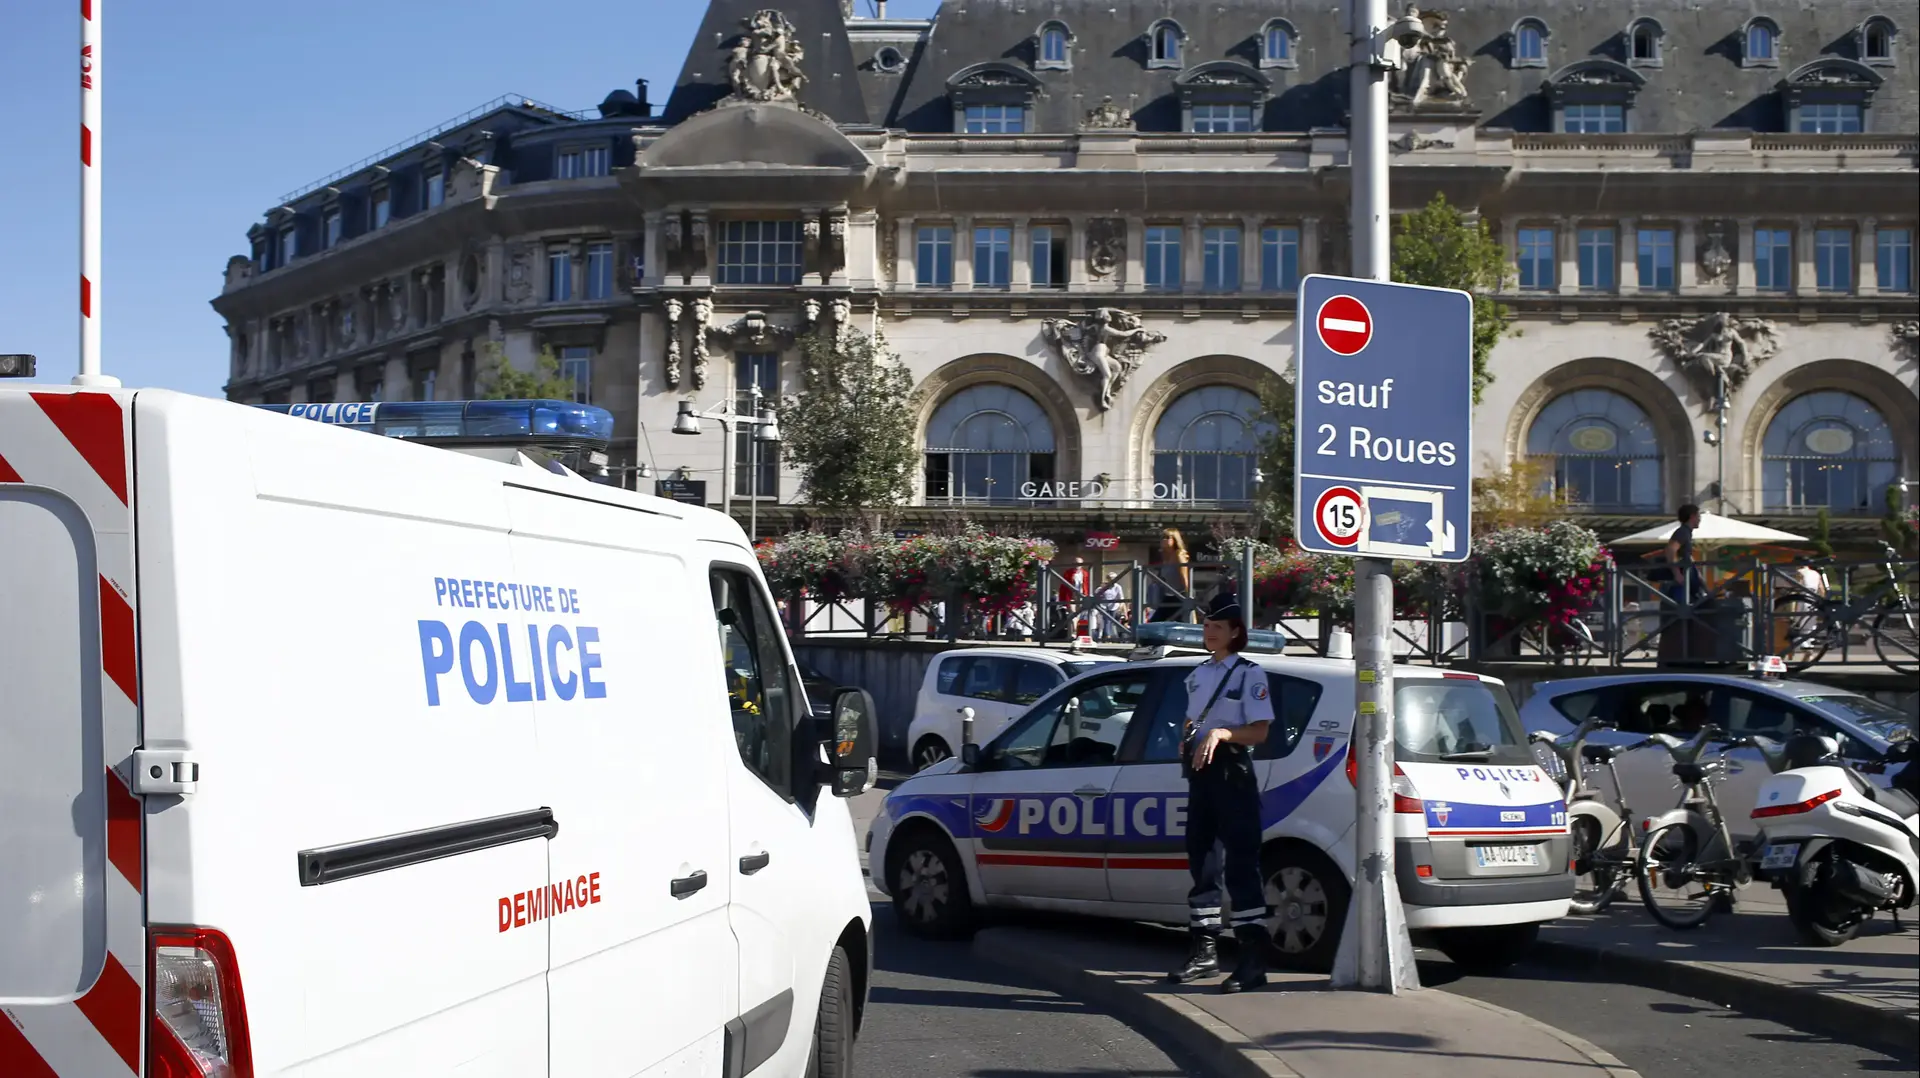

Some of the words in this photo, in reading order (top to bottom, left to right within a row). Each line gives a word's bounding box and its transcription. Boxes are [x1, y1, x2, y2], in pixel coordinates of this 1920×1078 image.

[1317, 378, 1394, 409] sauf
[291, 403, 374, 423] POLICE
[1317, 424, 1337, 456] 2
[1350, 426, 1456, 466] Roues
[1020, 481, 1080, 498] GARE
[1330, 504, 1355, 529] 15
[1085, 537, 1118, 548] SNCF
[434, 577, 555, 612] PREFECTURE
[558, 587, 580, 614] DE
[417, 620, 607, 706] POLICE
[1456, 767, 1529, 781] POLICE
[1018, 797, 1189, 836] POLICE
[498, 871, 601, 933] DEMINAGE
